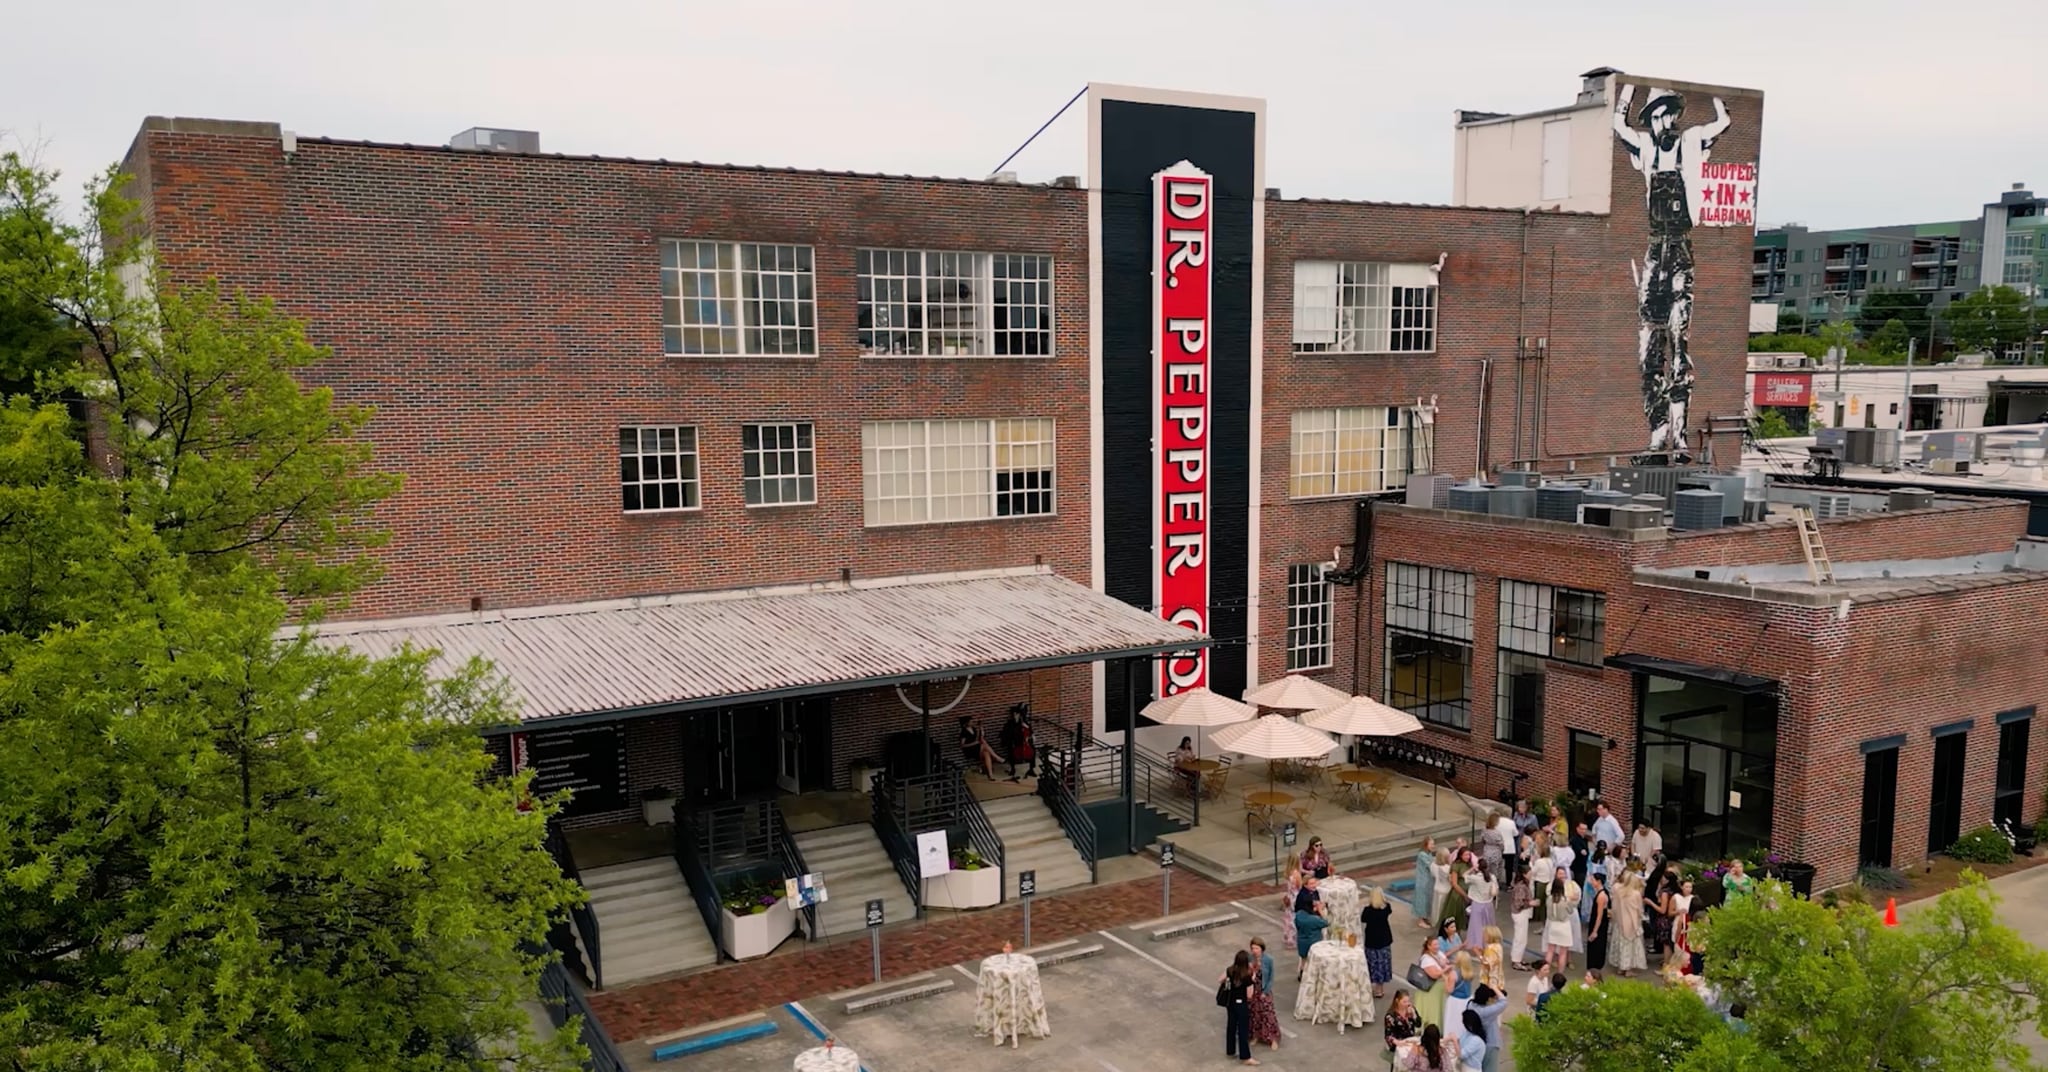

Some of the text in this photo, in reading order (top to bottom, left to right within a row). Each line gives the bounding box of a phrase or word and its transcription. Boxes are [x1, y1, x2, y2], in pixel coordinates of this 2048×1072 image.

[1701, 162, 1753, 181] ROOTED
[1716, 183, 1736, 206] IN
[1699, 207, 1752, 223] ALABAMA
[1166, 180, 1206, 289] DR.
[1166, 317, 1205, 577] PEPPER
